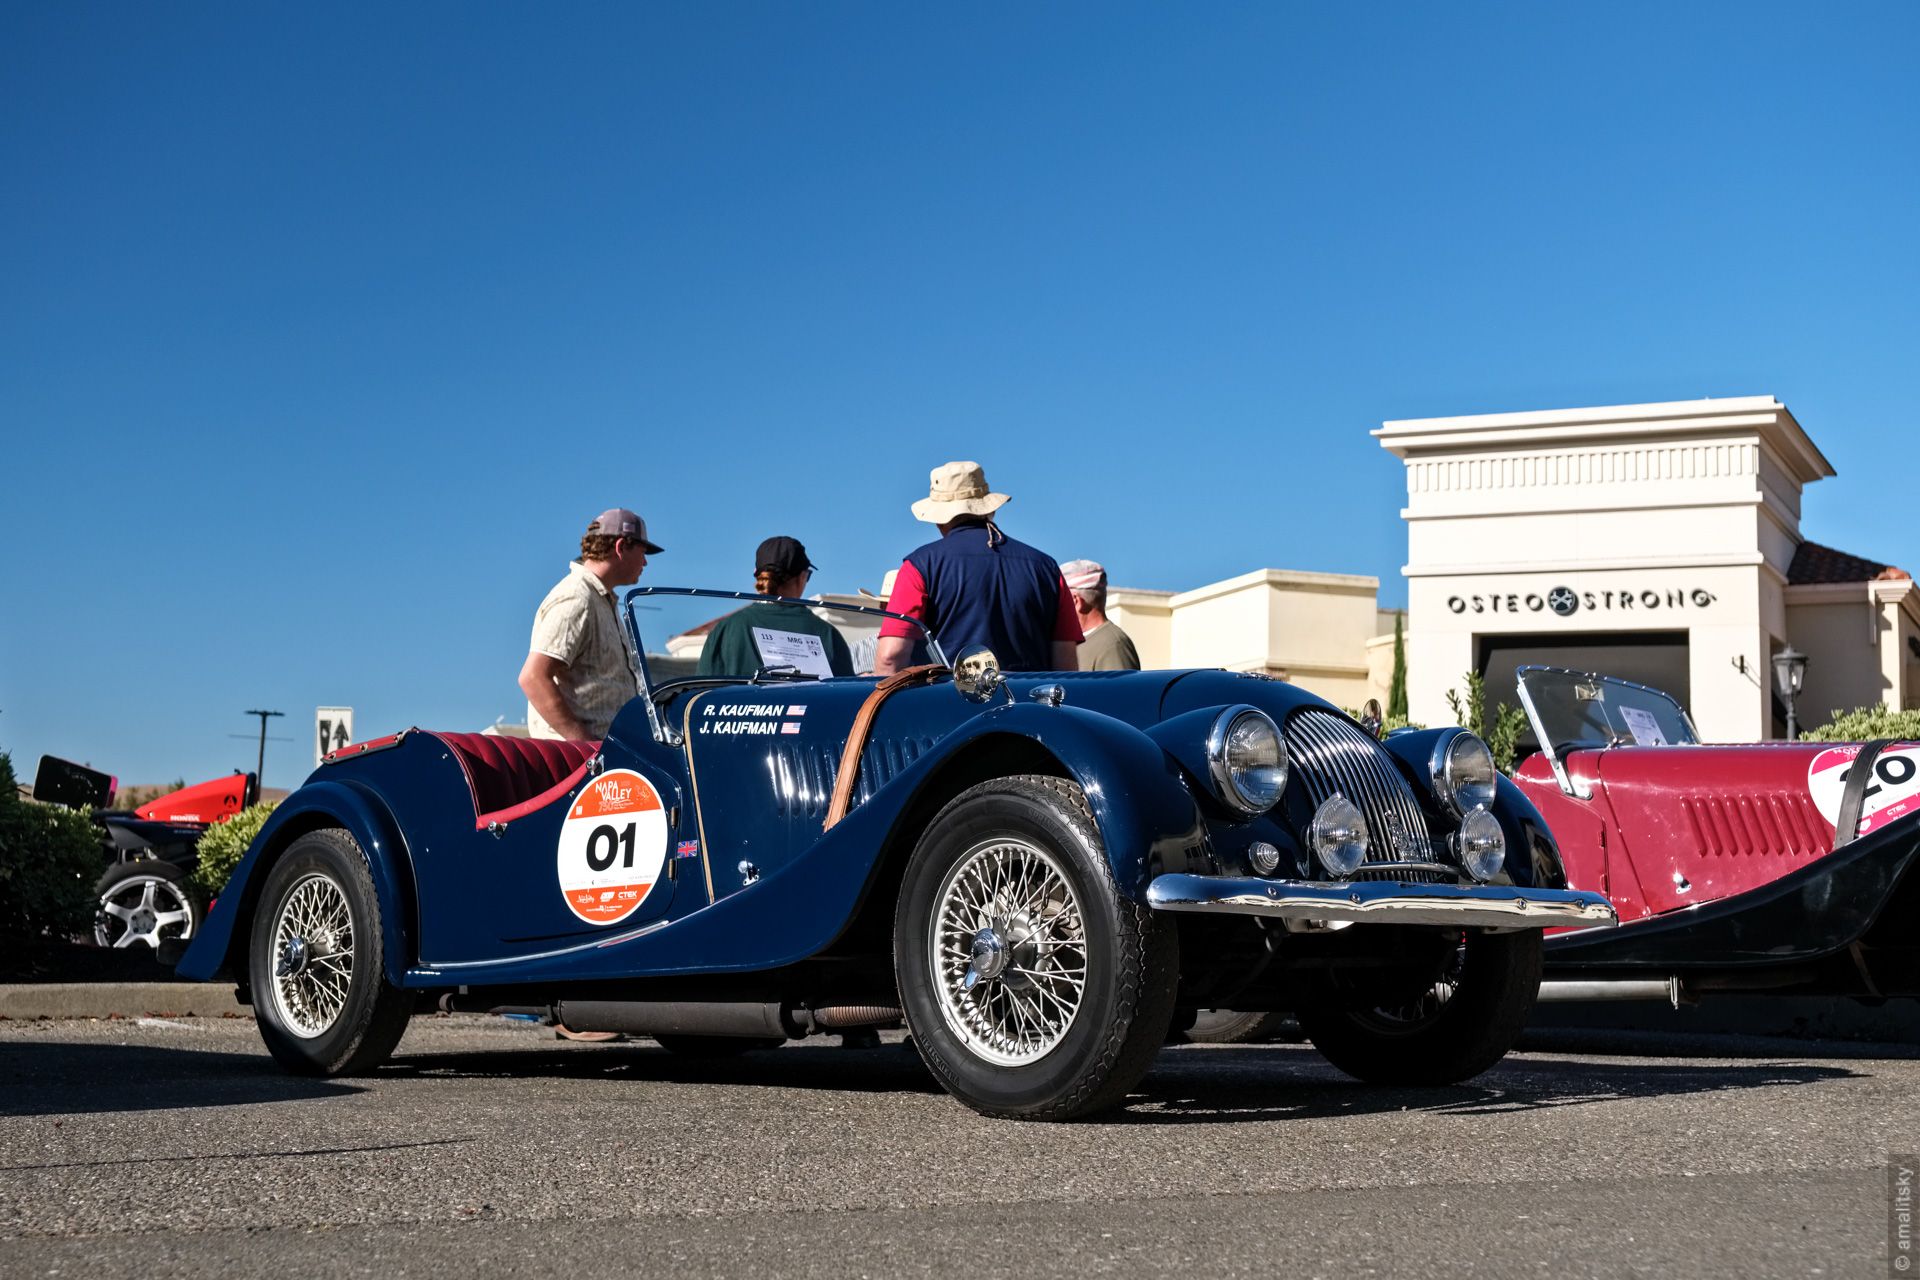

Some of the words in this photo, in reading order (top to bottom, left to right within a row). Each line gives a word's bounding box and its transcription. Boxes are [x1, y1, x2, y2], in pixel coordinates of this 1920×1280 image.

[761, 633, 774, 641] 113
[703, 704, 716, 716] R.
[718, 704, 784, 716] KAUFMAN
[699, 721, 710, 734] J.
[713, 722, 778, 734] KAUFMAN
[596, 781, 618, 793] NAPA
[602, 787, 632, 801] VALLEY
[586, 822, 637, 872] 01
